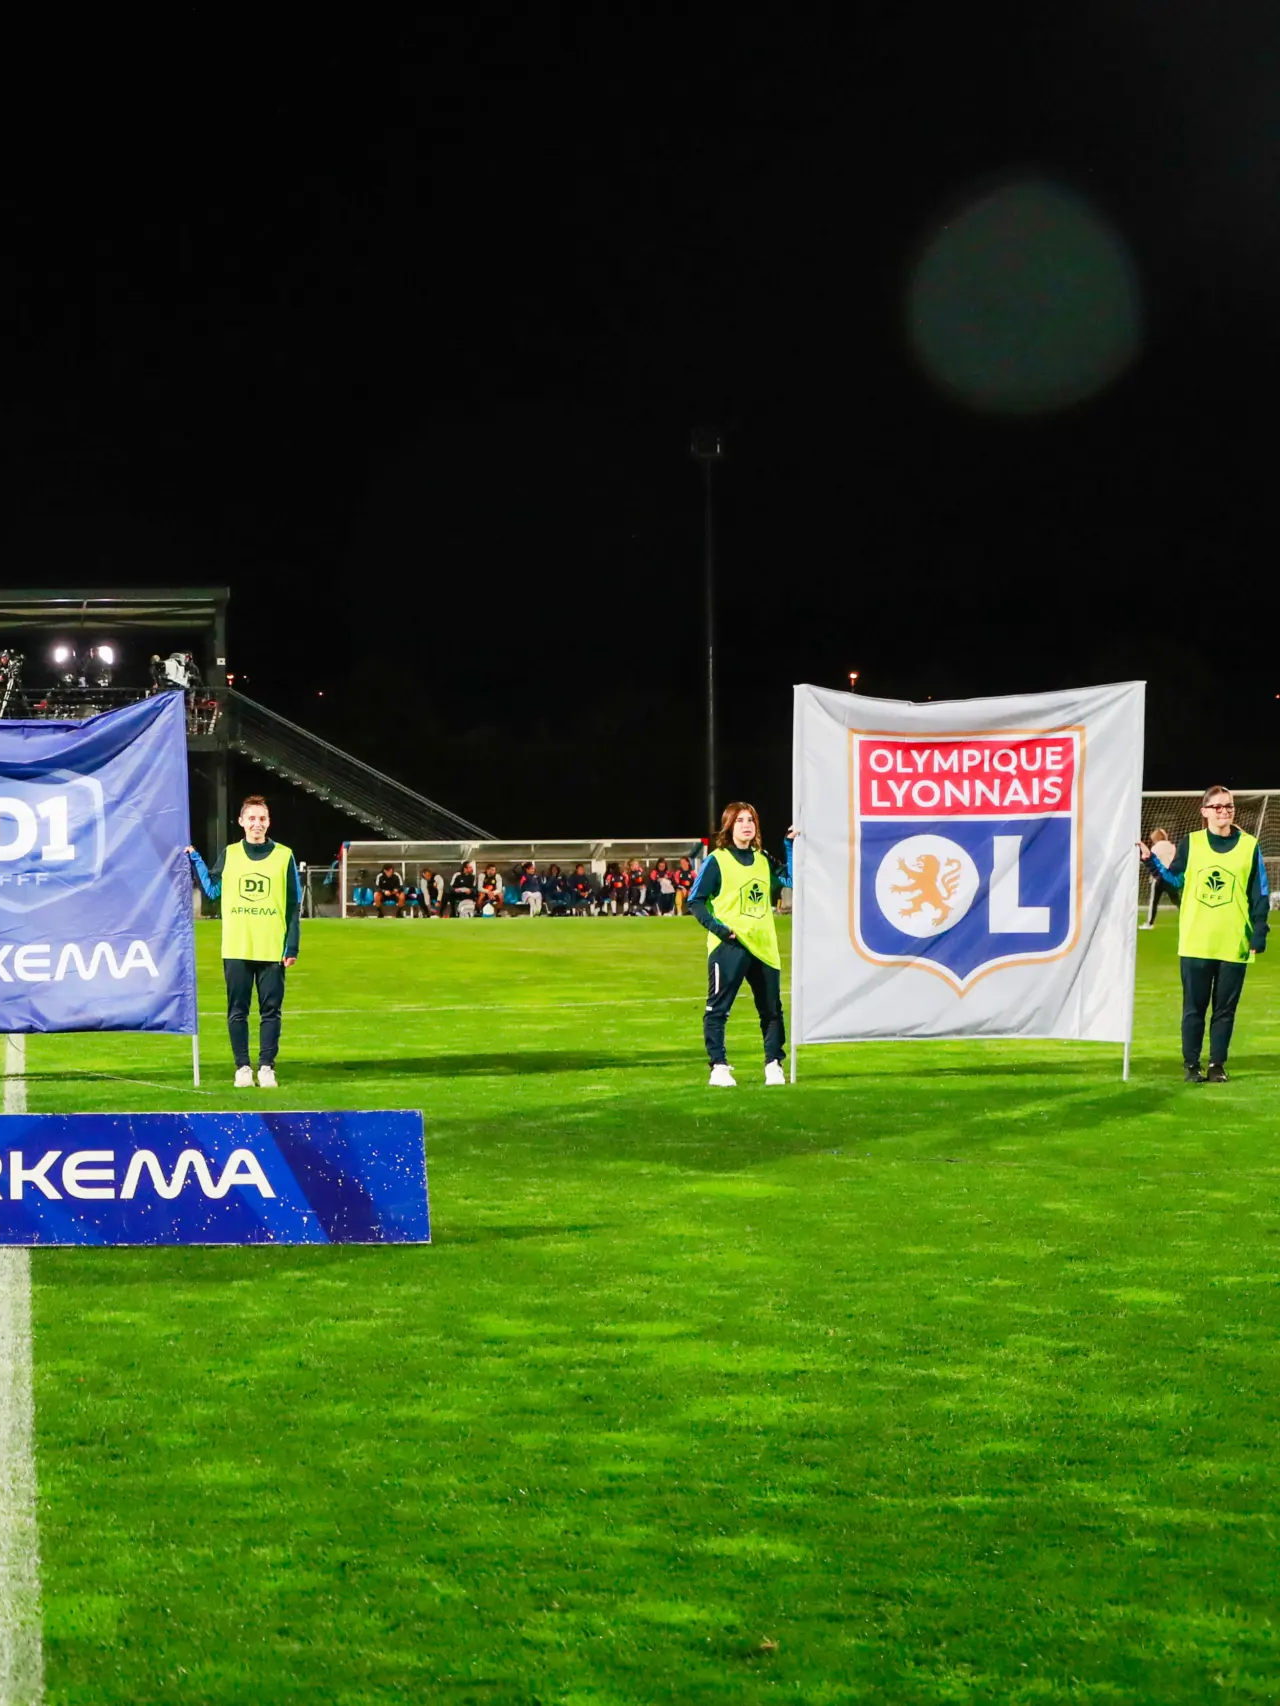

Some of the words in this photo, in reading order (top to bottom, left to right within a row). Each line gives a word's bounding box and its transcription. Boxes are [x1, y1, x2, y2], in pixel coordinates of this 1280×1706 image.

[870, 747, 1064, 775] OLYMPIQUE
[871, 777, 1063, 808] LYONNAIS
[244, 879, 265, 893] D1
